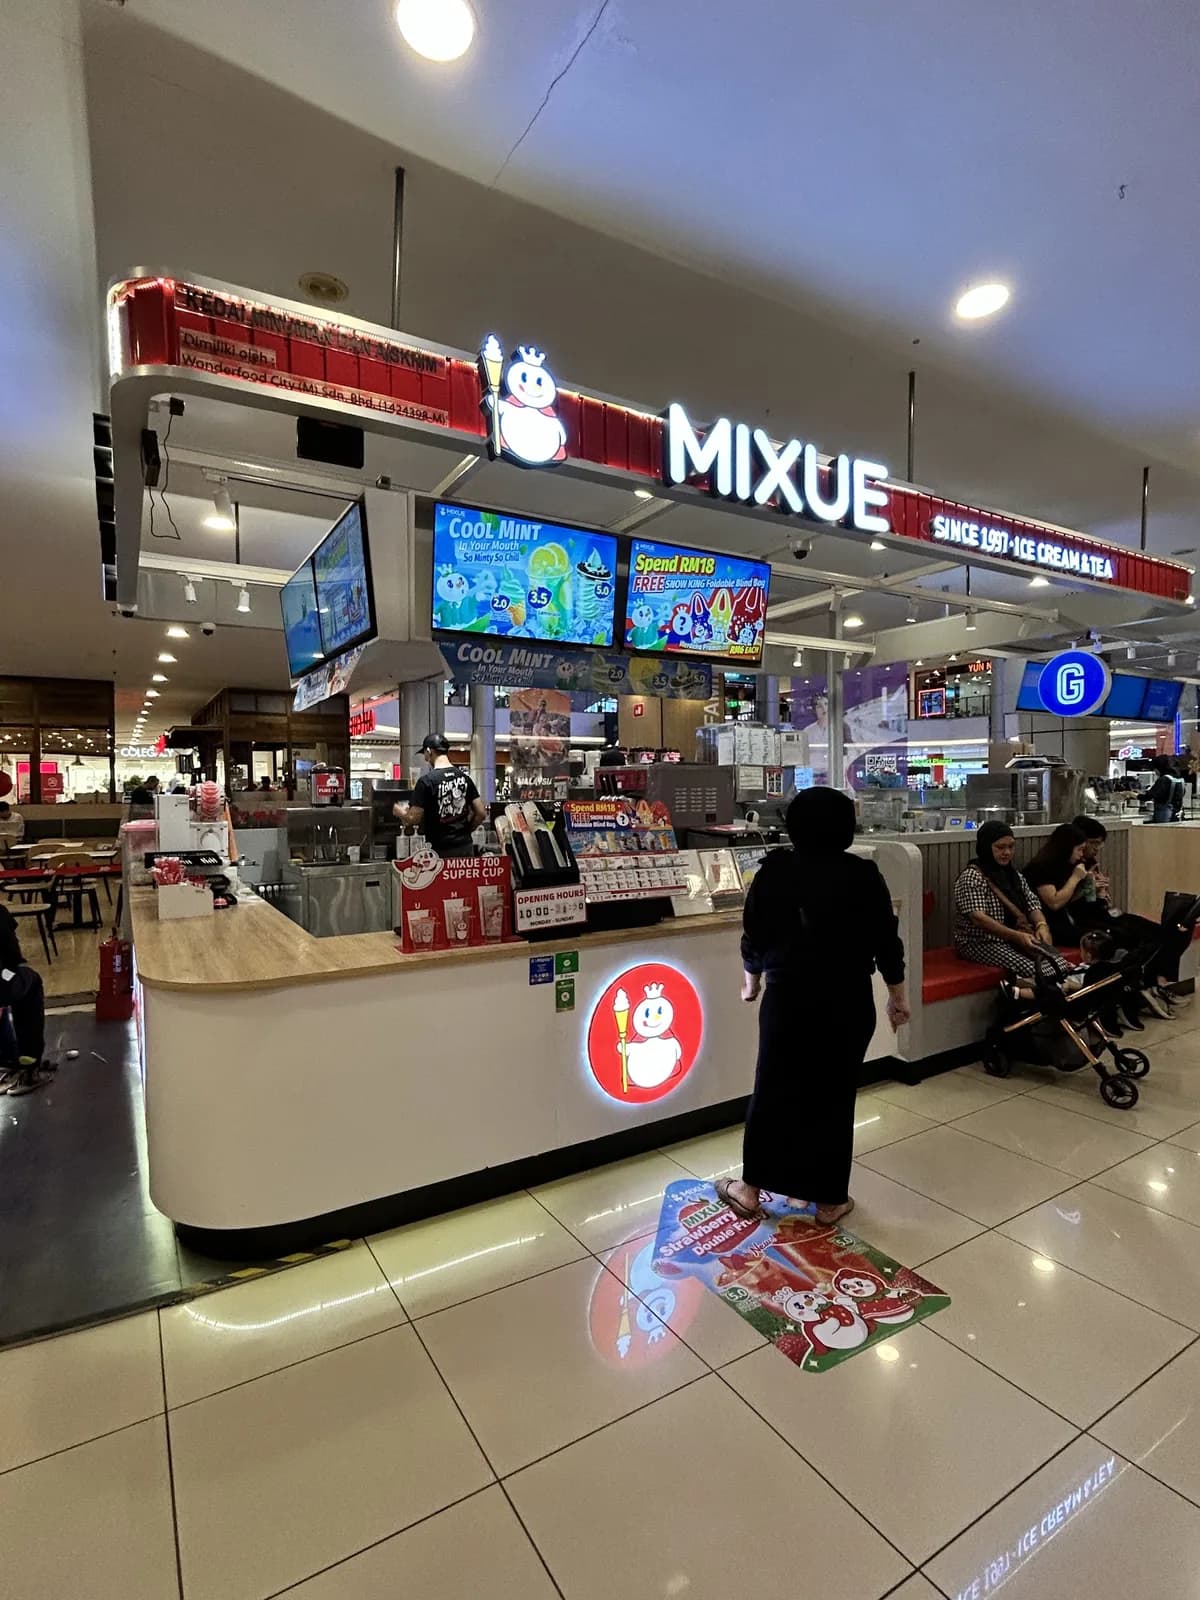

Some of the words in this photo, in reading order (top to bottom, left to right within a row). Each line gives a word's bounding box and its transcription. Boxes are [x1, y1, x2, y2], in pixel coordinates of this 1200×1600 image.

[186, 288, 247, 322] KEDAI
[183, 332, 236, 357] Dimiliki
[239, 349, 268, 364] oleh
[182, 353, 267, 384] Wonderfood
[270, 375, 295, 391] City
[321, 386, 348, 402] Sdn.
[669, 402, 890, 533] MIXUE
[459, 540, 468, 551] In
[470, 541, 491, 551] Your
[491, 541, 519, 551] Mouth
[933, 514, 980, 546] SINCE
[1036, 542, 1080, 571] CREAM
[1080, 552, 1090, 574] &
[1089, 555, 1113, 579] TEA
[463, 552, 473, 562] So
[494, 553, 504, 562] So
[635, 554, 679, 575] Spend
[679, 557, 715, 574] RM18
[632, 576, 665, 593] FREE
[664, 579, 688, 589] SNOW
[705, 579, 735, 589] Foldable
[530, 592, 548, 605] 3.5
[596, 588, 610, 596] 5.0
[493, 599, 508, 608] 2.0
[487, 664, 507, 674] Your
[507, 666, 533, 676] Mouth
[610, 669, 624, 679] 2.0
[968, 663, 984, 673] YUN
[1056, 661, 1086, 706] G
[570, 803, 594, 813] Spend
[595, 803, 616, 813] RM18
[446, 859, 480, 870] MIXUE
[482, 857, 500, 867] 700
[442, 869, 480, 880] SUPER
[482, 867, 504, 878] CUP
[518, 893, 555, 905] OPENING
[556, 889, 584, 900] HOURS
[683, 1201, 726, 1227] MIXUE
[659, 1211, 738, 1258] Strawberry
[692, 1230, 736, 1256] Double
[729, 1288, 748, 1300] 5.0
